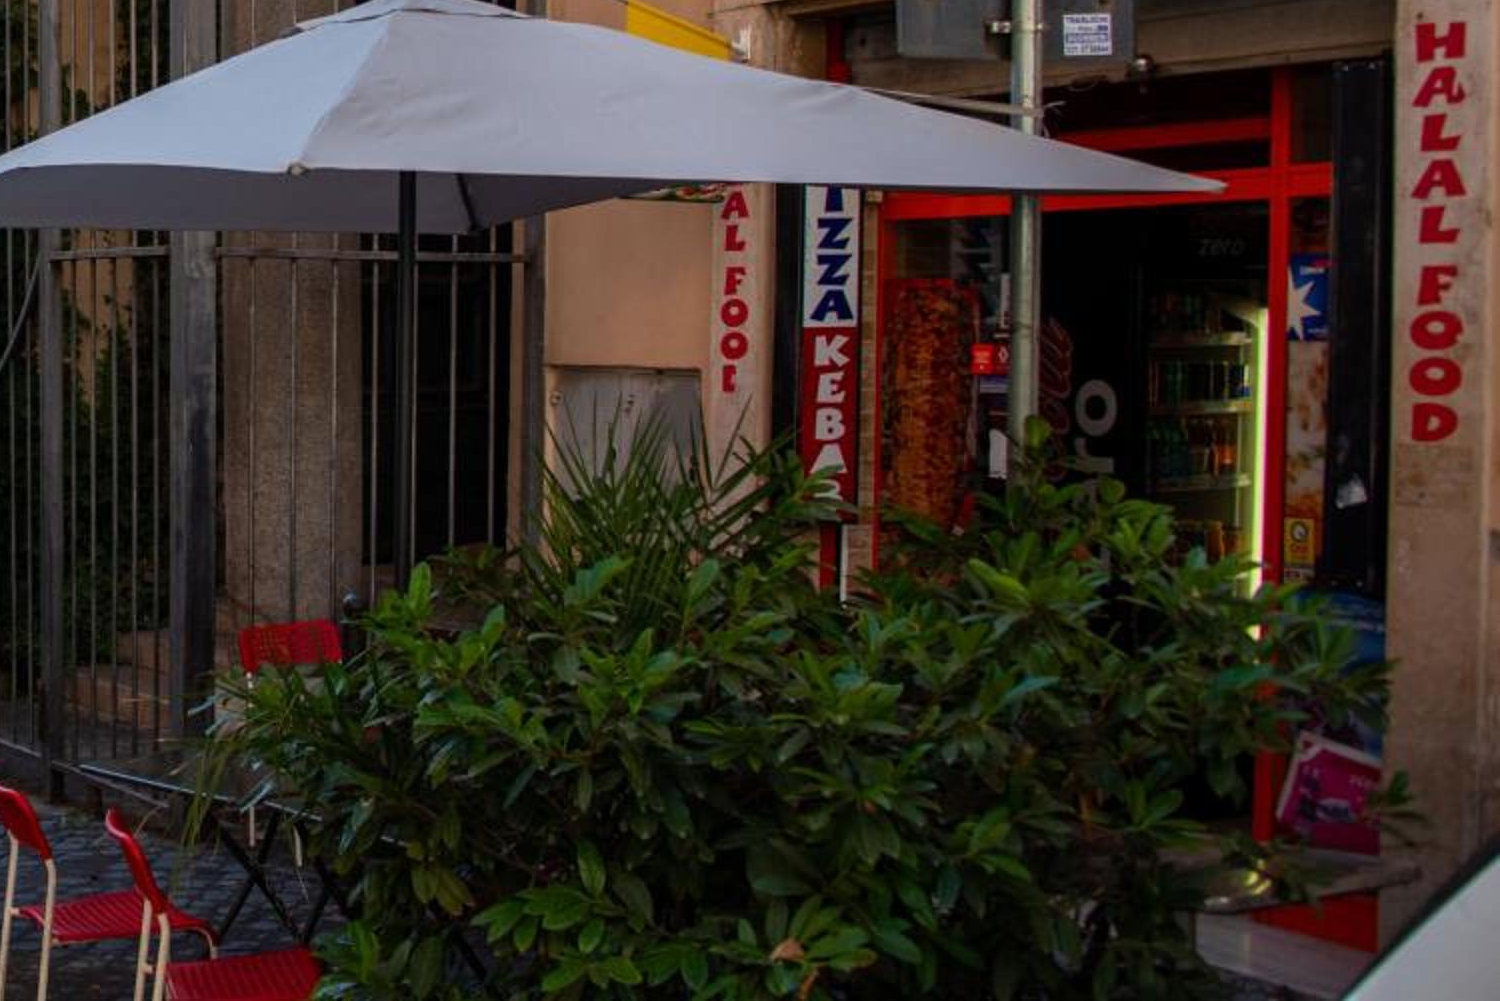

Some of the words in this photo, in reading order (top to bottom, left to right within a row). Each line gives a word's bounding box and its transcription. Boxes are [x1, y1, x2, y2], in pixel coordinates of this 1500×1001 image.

[1411, 21, 1467, 244] HALAL
[809, 183, 854, 321] IZZA
[1409, 264, 1464, 443] FOOD
